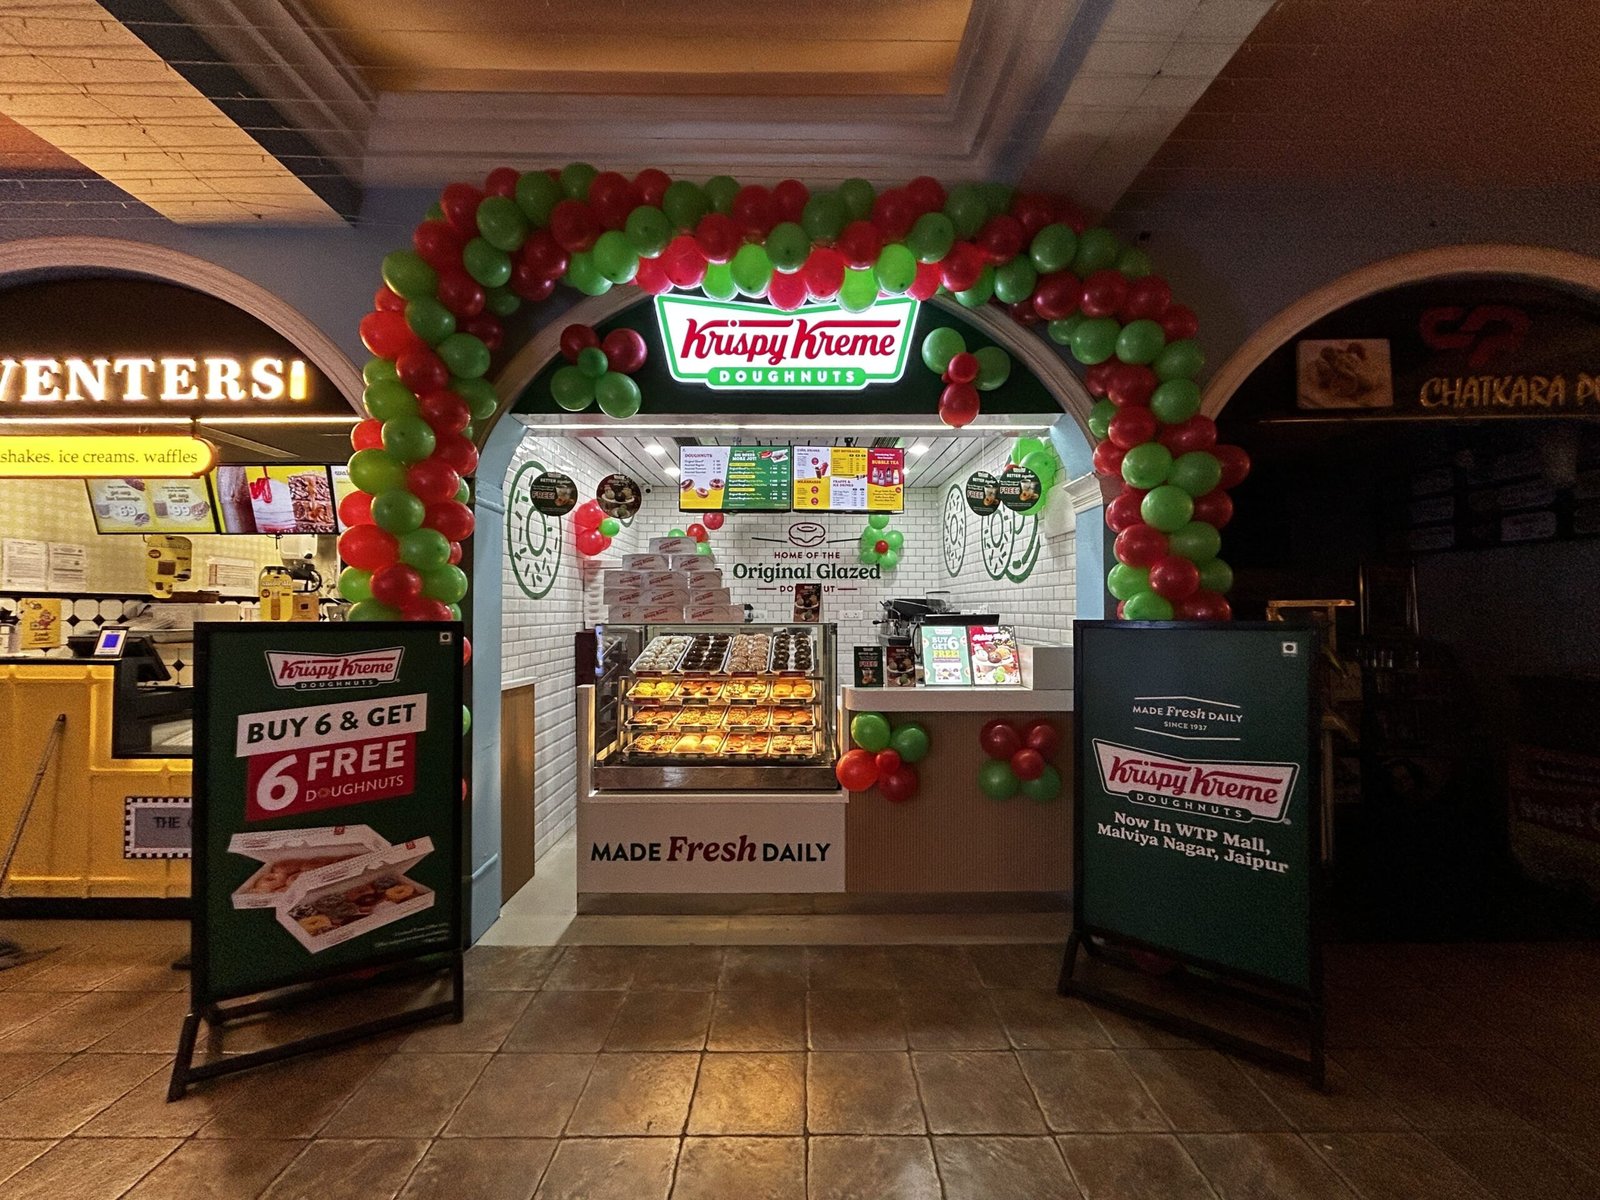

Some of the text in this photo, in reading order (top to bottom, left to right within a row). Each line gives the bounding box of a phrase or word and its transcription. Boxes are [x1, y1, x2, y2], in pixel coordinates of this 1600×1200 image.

[681, 318, 901, 366] Krispy Kreme
[719, 370, 855, 384] DOUGHNUTS
[1420, 374, 1566, 408] CHATKARA
[58, 449, 80, 464] ice
[82, 453, 139, 464] creams.
[144, 448, 198, 464] waffles
[774, 551, 840, 559] HOME OF THE
[732, 562, 881, 584] Original Glazed
[779, 585, 835, 593] DOUT
[948, 636, 960, 650] 6
[279, 656, 396, 680] Krispy Kreme
[300, 679, 375, 689] DOUGHNUTS
[246, 703, 417, 745] BUY 6 & GET
[1132, 704, 1243, 723] MADE Fresh DAILY
[1163, 720, 1208, 732] SINCE 1937
[256, 739, 407, 812] 6 FREE
[1108, 755, 1284, 805] Krispy Kreme
[1135, 793, 1243, 818] DOUGHNUTS
[152, 816, 181, 830] THE
[1113, 811, 1272, 857] Now In WTP Mall,
[590, 834, 831, 863] MADE Fresh DAILY
[1097, 822, 1290, 874] Malviya Nagar, Jaipur
